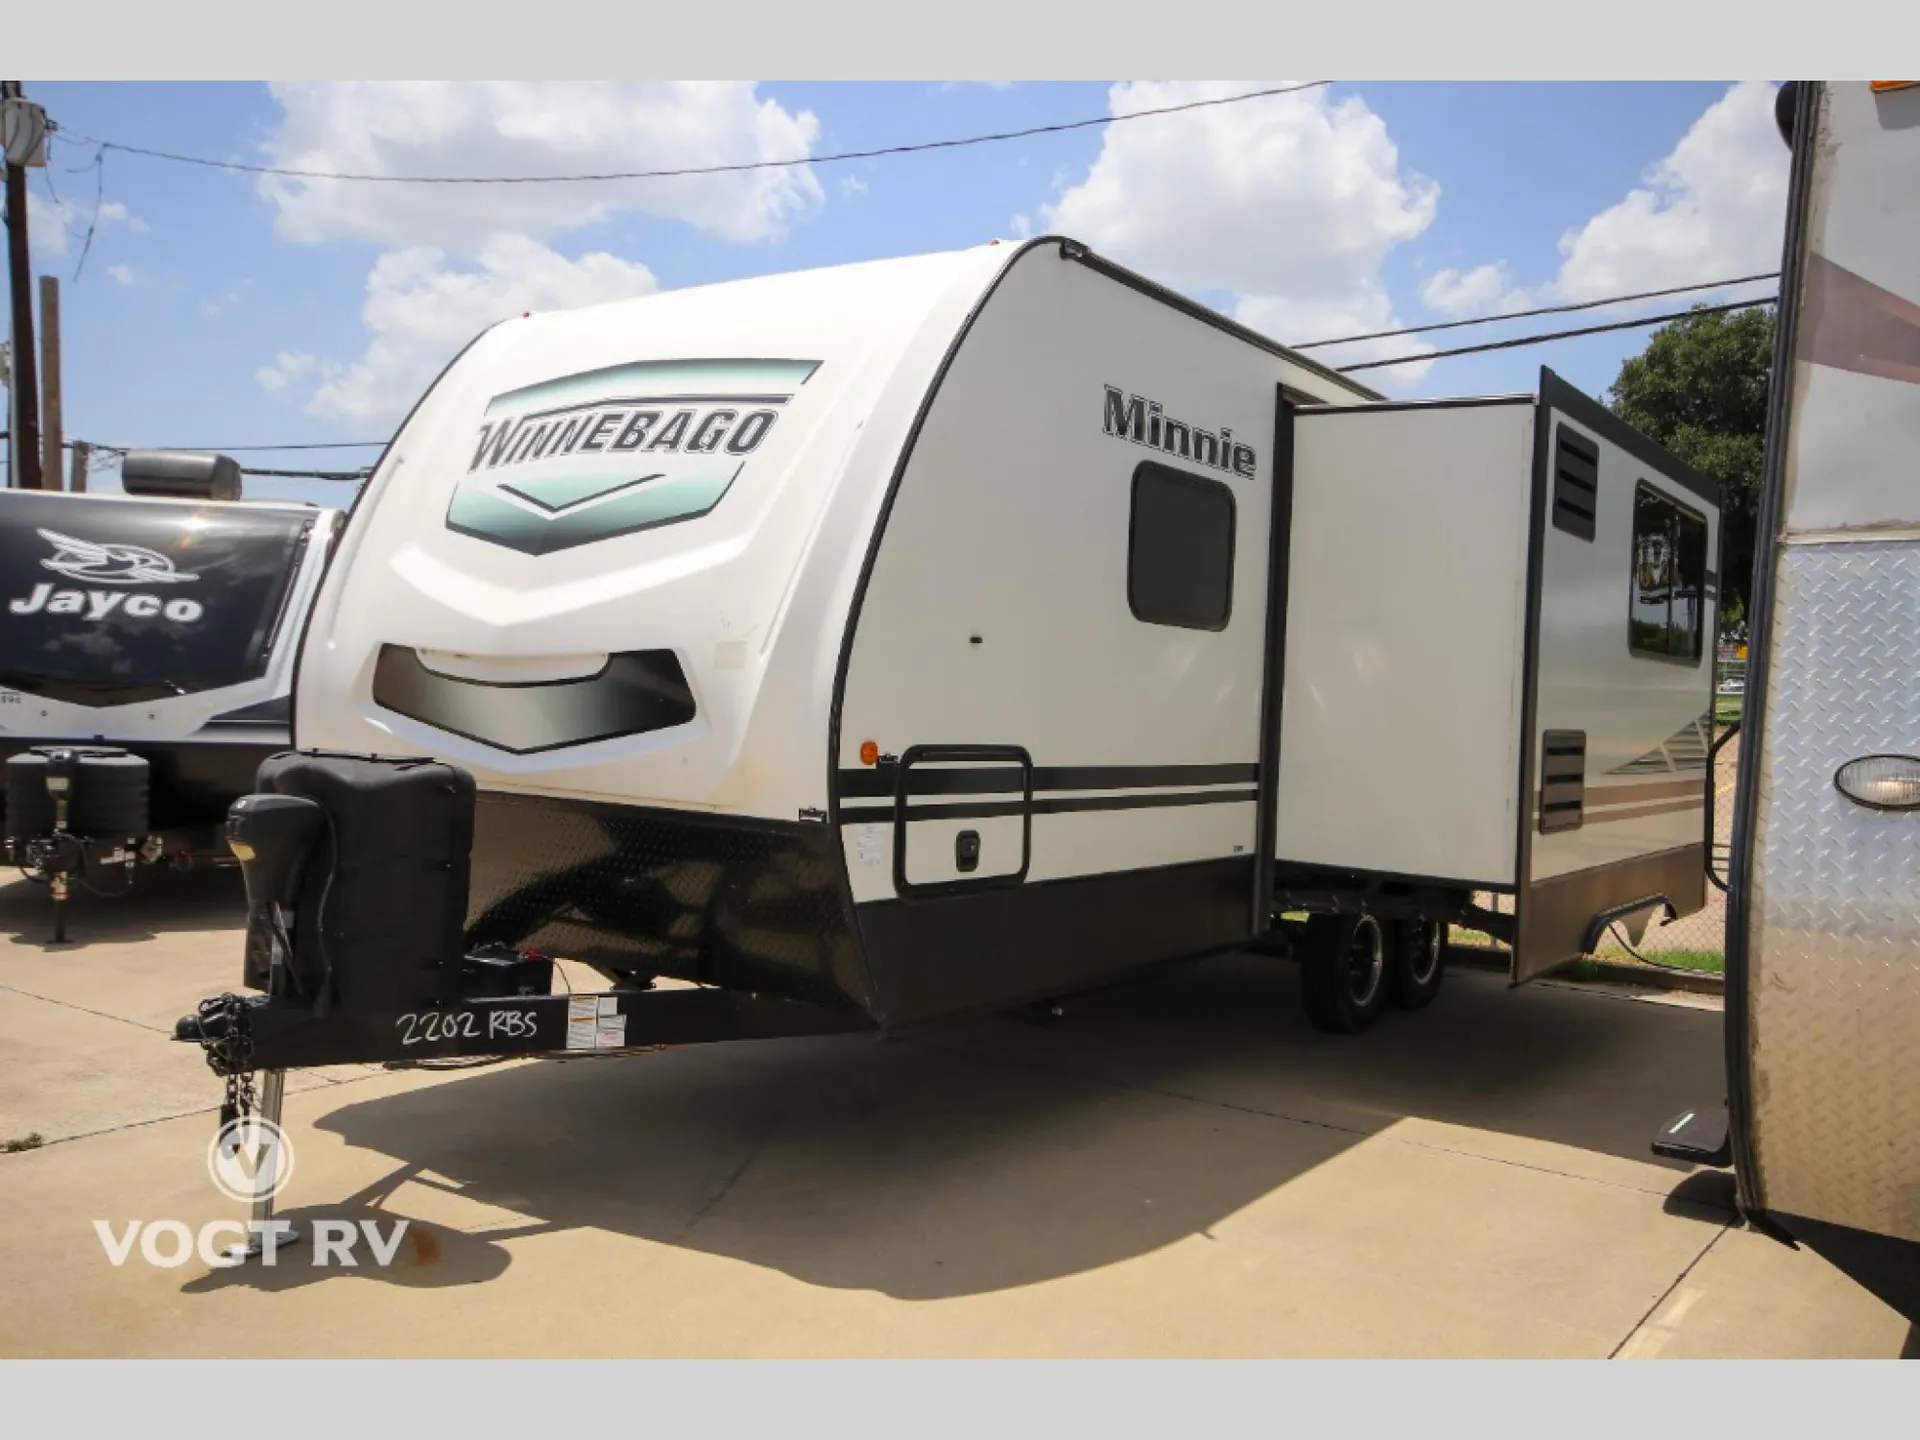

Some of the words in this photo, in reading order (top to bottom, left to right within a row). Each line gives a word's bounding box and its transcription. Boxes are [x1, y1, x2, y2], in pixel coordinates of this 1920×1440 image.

[467, 409, 778, 474] WINNEBAGO
[1103, 384, 1256, 480] Minnie
[10, 583, 203, 622] Jayco
[396, 1011, 481, 1045] 2202
[489, 1010, 537, 1039] RBS
